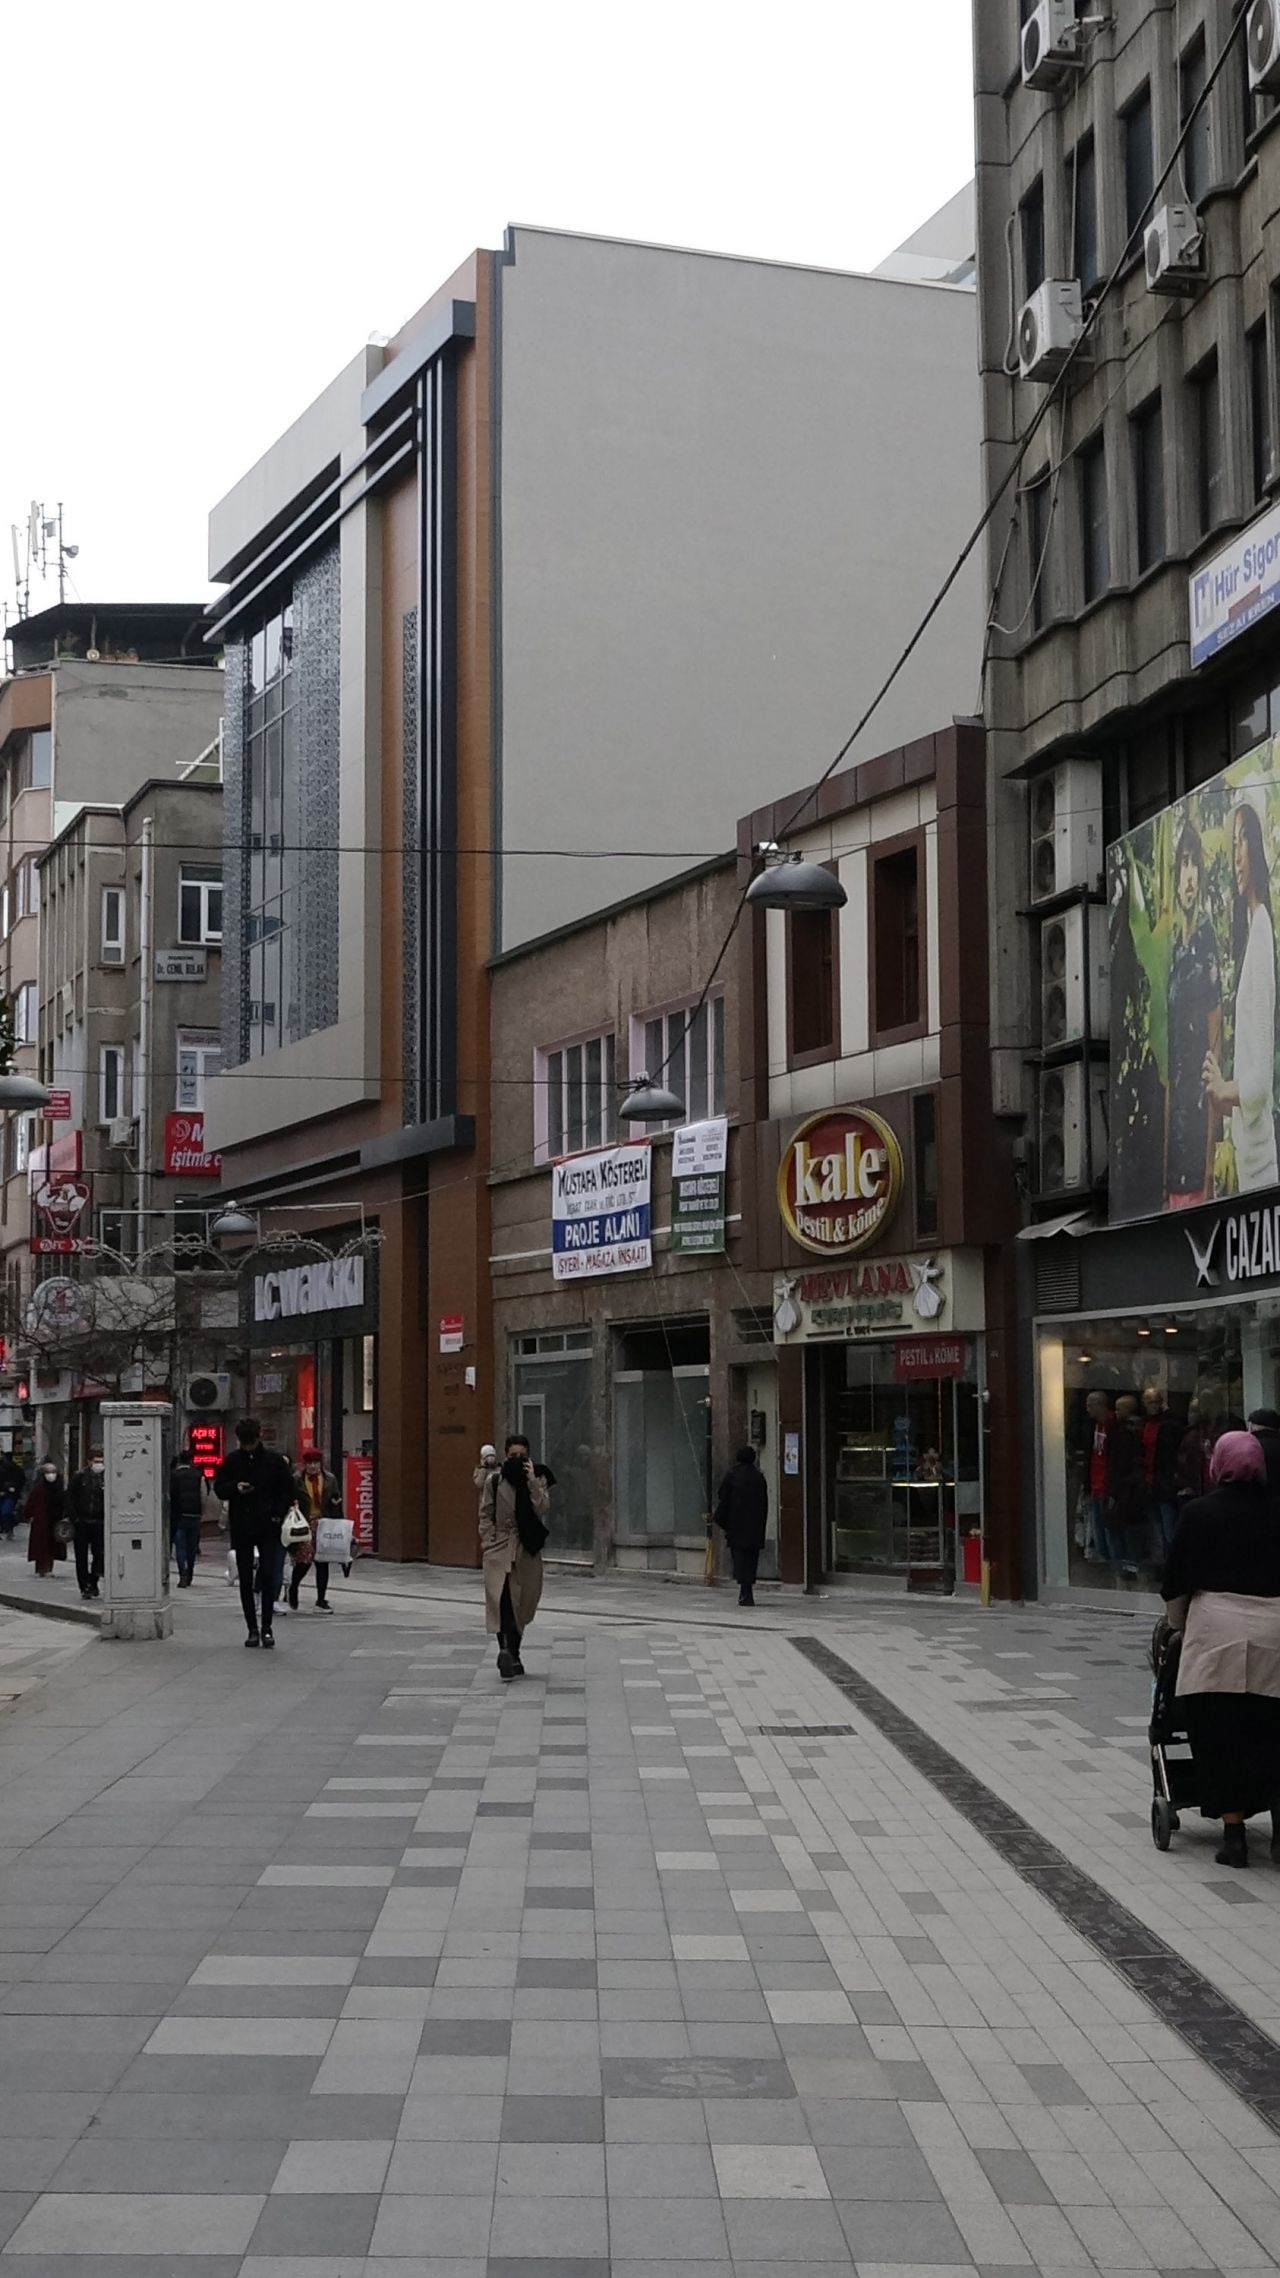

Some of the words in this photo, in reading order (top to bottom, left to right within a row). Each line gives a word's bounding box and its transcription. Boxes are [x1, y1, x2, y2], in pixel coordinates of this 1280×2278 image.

[1215, 563, 1240, 606] Hür
[170, 1145, 211, 1171] işitme
[793, 1131, 883, 1206] kale
[558, 1168, 597, 1197] MUSTAFA
[565, 1220, 600, 1248] PROJE
[604, 1211, 640, 1242] ALANI
[833, 1217, 846, 1243] &
[848, 1196, 888, 1240] köme
[585, 1249, 615, 1270] MAĞAZA
[800, 1262, 911, 1302] MEVLANA
[899, 1345, 928, 1367] PESTİL
[934, 1343, 960, 1365] KÖME
[355, 1470, 374, 1543] İNDİRİM
